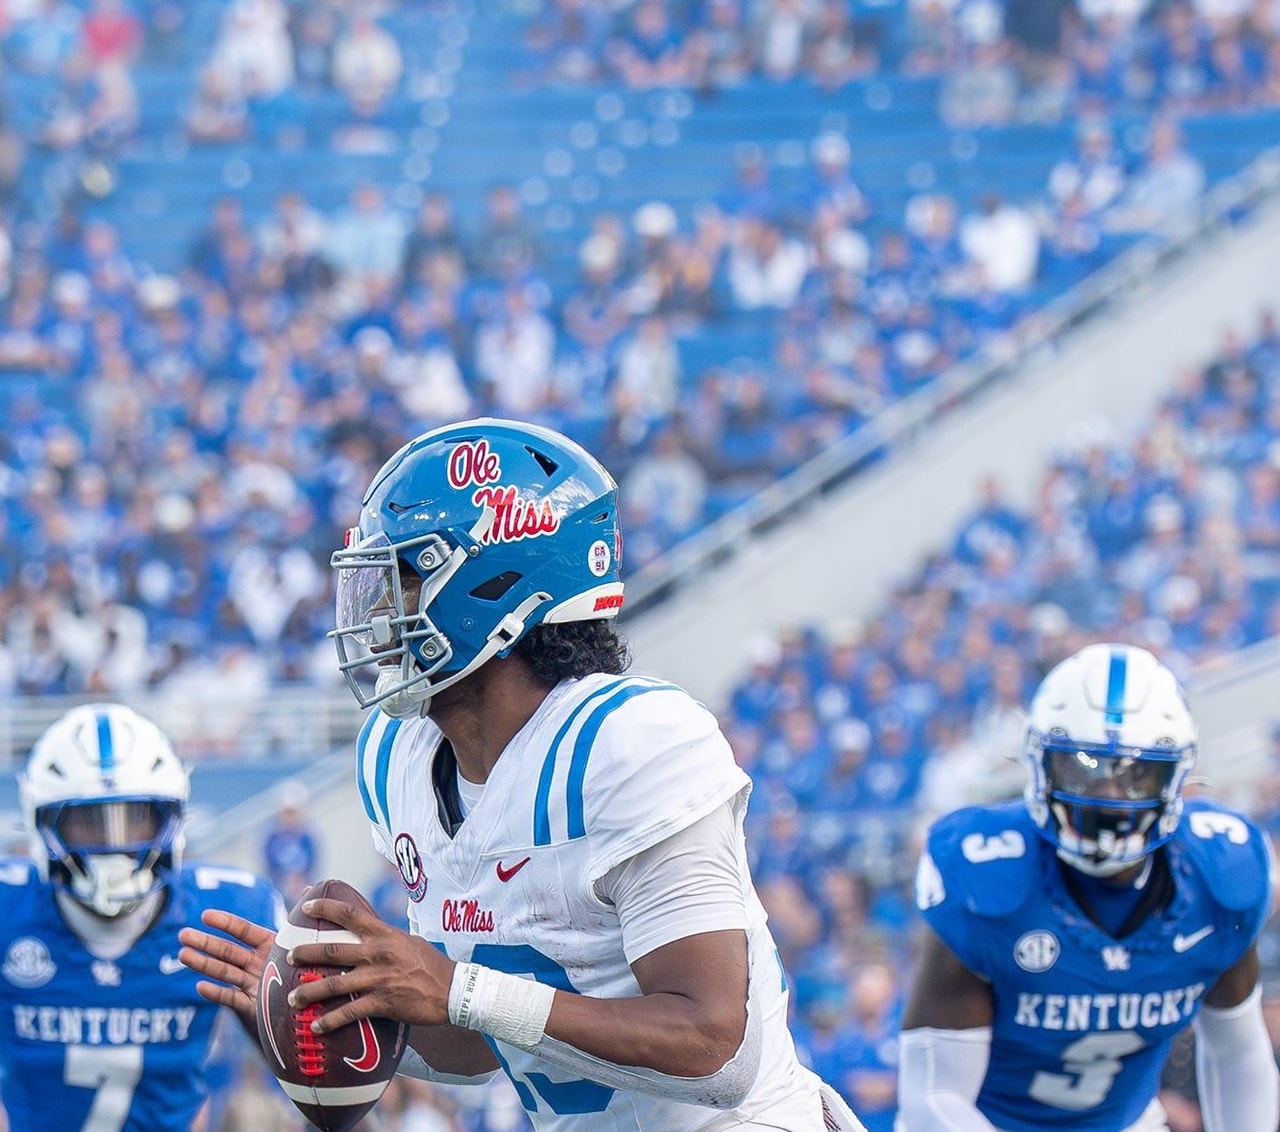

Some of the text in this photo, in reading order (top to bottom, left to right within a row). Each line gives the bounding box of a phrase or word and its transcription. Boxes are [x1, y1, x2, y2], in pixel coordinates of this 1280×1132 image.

[447, 439, 502, 490] Ole
[472, 485, 564, 545] Miss
[595, 560, 606, 571] 91
[961, 829, 1026, 864] 3
[1188, 811, 1250, 845] 3
[442, 899, 495, 933] Ole Miss
[13, 1003, 198, 1044] KENTUCKY
[1014, 981, 1207, 1032] KENTUCKY
[1027, 1029, 1148, 1112] 3
